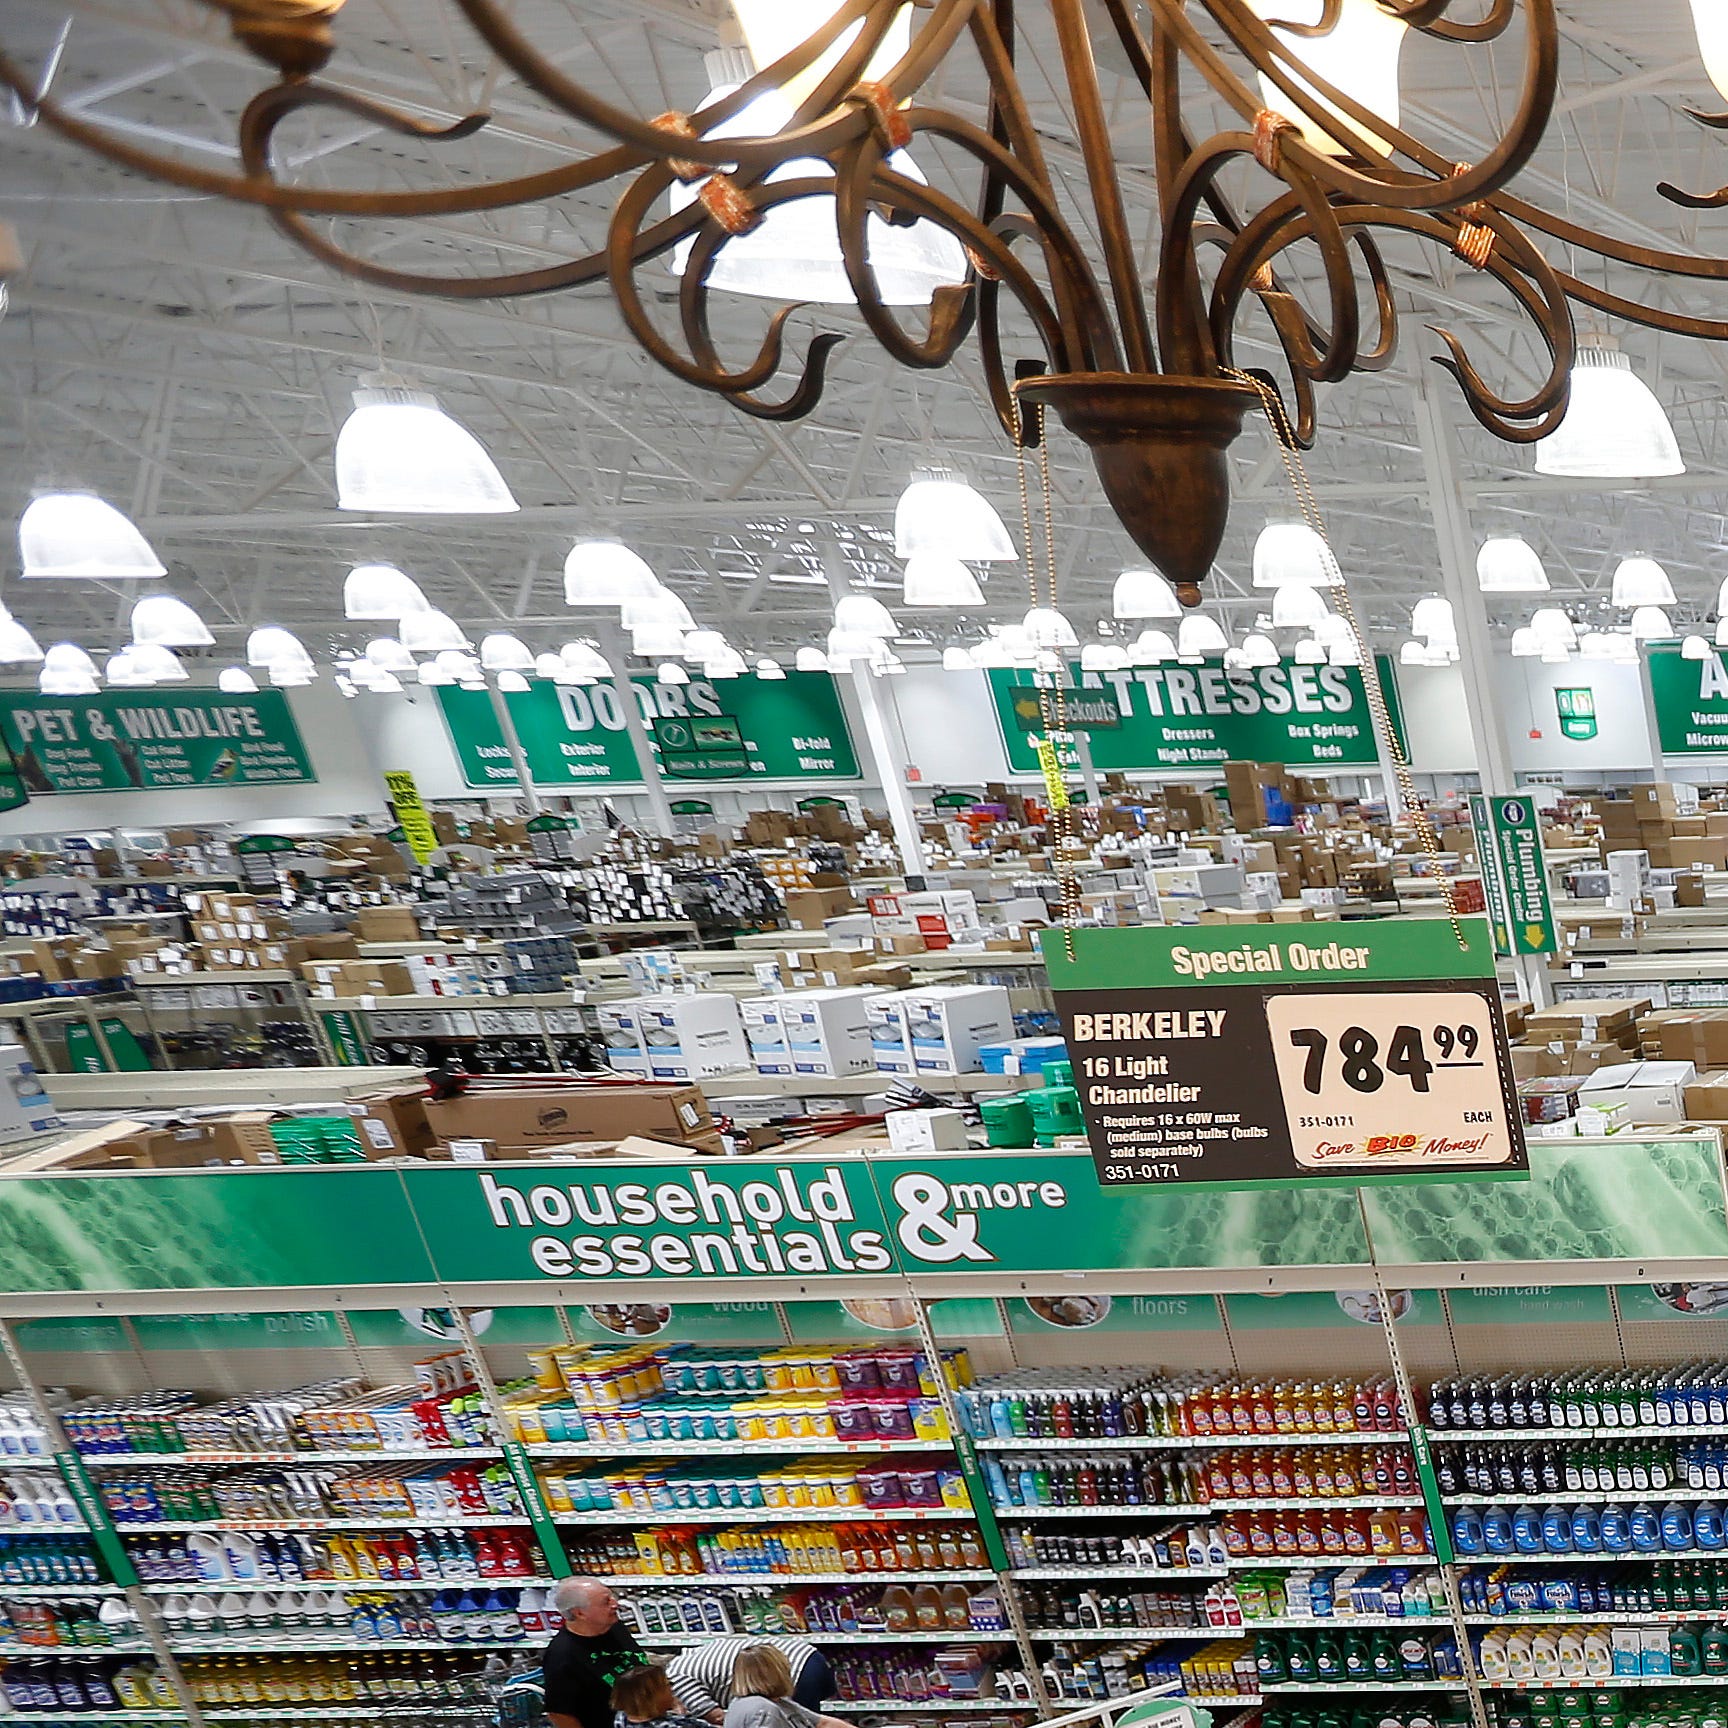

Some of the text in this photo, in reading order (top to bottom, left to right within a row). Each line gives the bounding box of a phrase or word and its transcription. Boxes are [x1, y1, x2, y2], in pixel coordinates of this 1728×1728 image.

[11, 706, 266, 742] PET WILDLIFE
[1515, 829, 1545, 922] Plumbing
[1173, 943, 1370, 980] Special Order
[1073, 1009, 1227, 1042] BERKELEY
[1082, 1055, 1169, 1082] 16 Light
[1089, 1084, 1201, 1106] Chandelier
[1103, 1112, 1240, 1129] Requires 60W max
[1300, 1111, 1493, 1128] 351-0171 EACH
[1107, 1126, 1268, 1145] (medium) base bulbs (bulbs
[1312, 1142, 1355, 1160] Save
[1420, 1132, 1491, 1157] Money!
[1110, 1143, 1204, 1160] sold separately)
[1105, 1164, 1179, 1180] 351-0171
[478, 1166, 857, 1228] household
[949, 1179, 1066, 1211] more
[530, 1218, 892, 1279] essentials
[1128, 1295, 1190, 1315] floors
